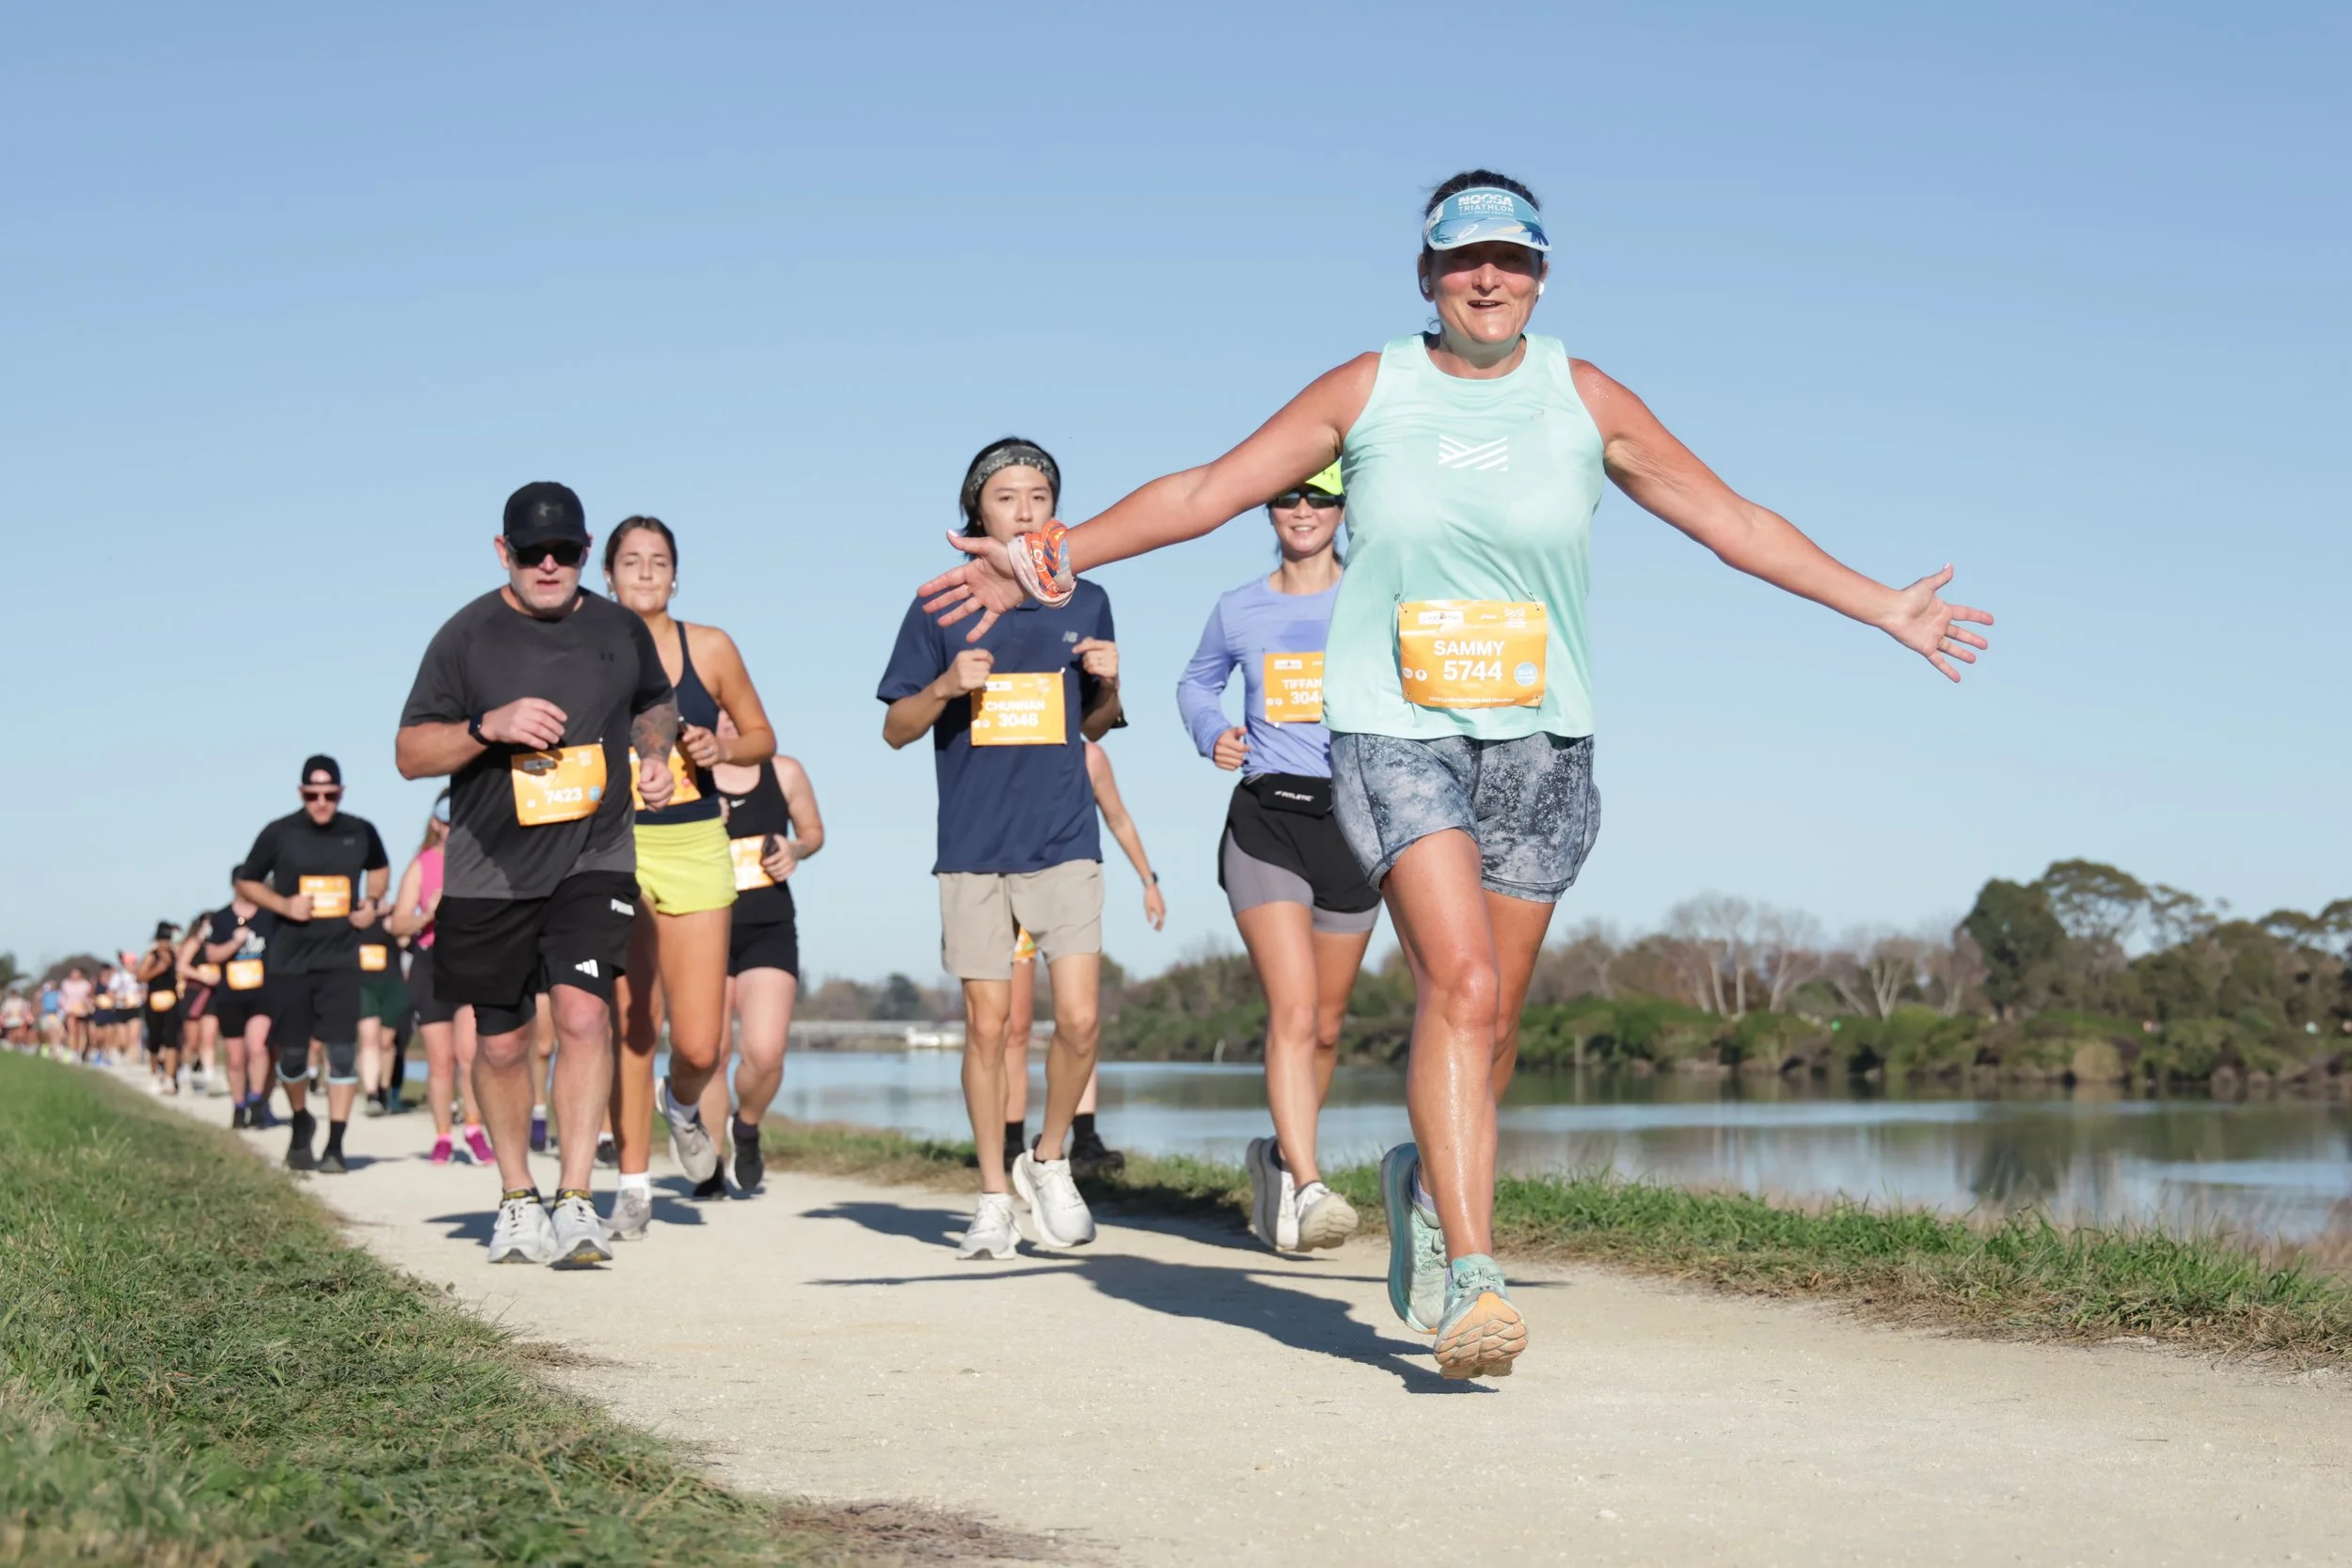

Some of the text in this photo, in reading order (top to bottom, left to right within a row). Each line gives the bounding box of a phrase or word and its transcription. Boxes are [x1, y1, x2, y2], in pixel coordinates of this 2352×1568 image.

[1458, 193, 1513, 207] NOOSA
[1458, 203, 1514, 213] TRIATHLON
[1434, 640, 1505, 657] SAMMY
[1443, 660, 1502, 681] 5744
[1281, 678, 1323, 689] TIFFAN
[1290, 690, 1323, 705] 304
[544, 786, 582, 804] 7423
